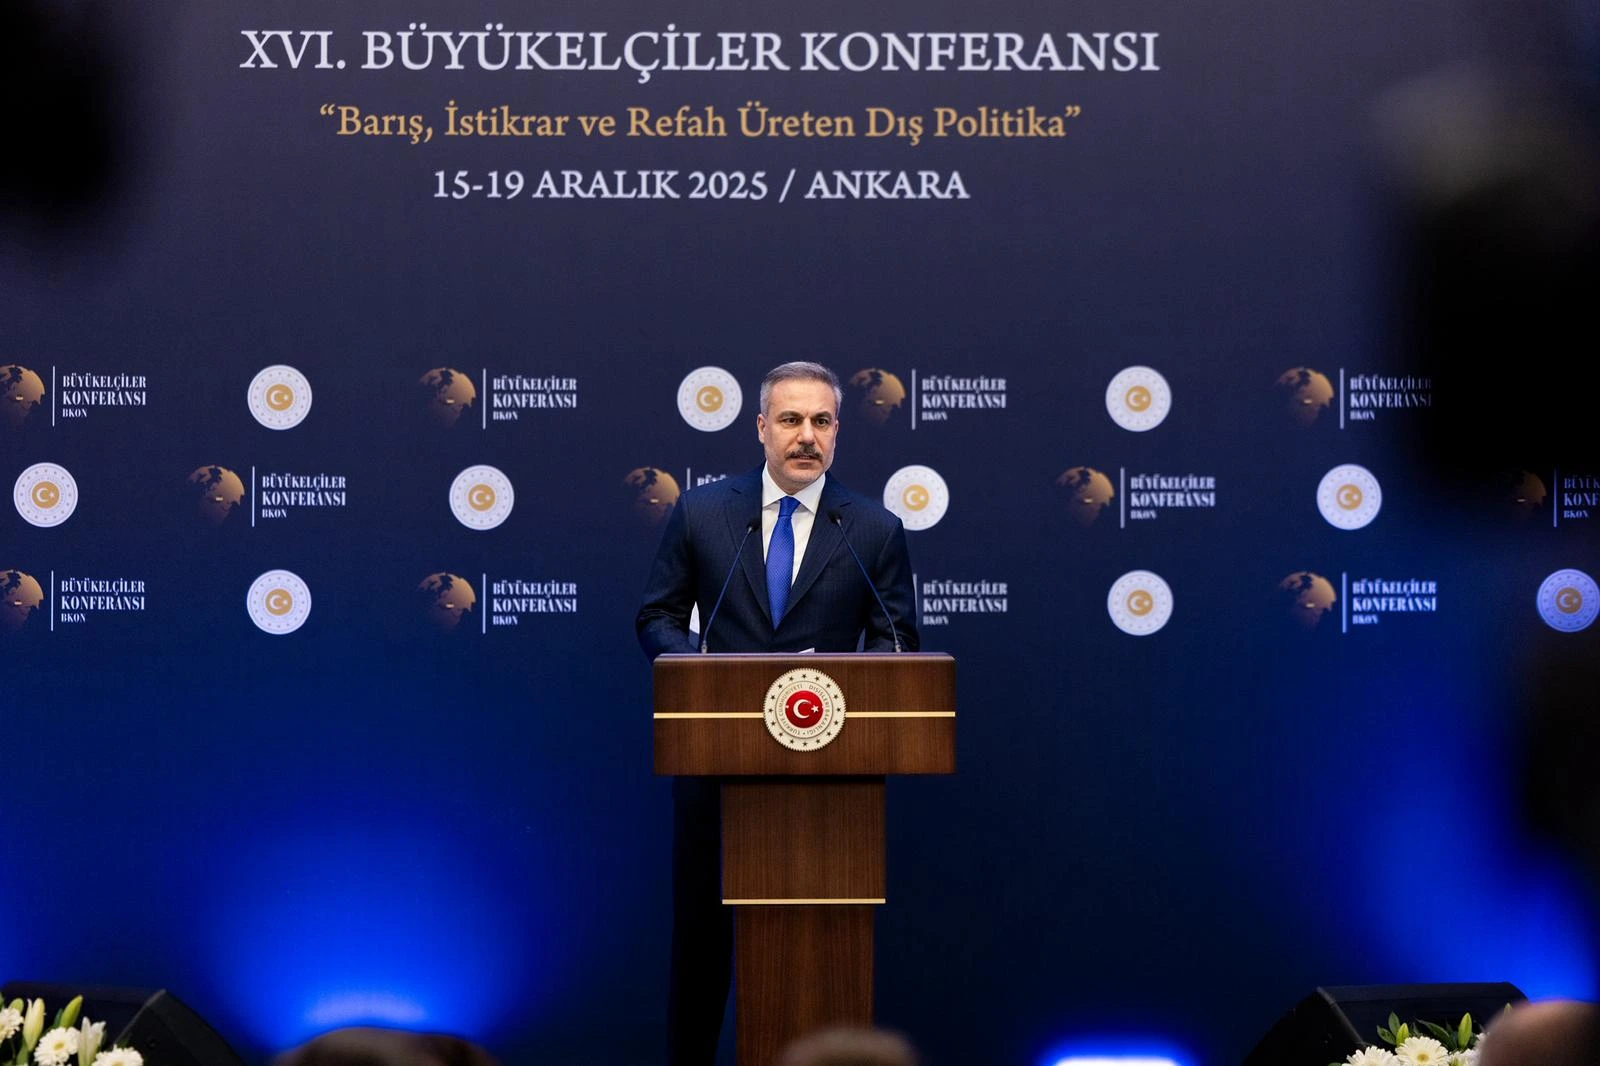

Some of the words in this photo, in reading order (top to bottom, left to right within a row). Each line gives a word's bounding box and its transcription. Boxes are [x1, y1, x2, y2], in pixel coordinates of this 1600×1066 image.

[239, 30, 347, 70] XVI.
[361, 22, 791, 84] BÜYÜKELÇİLER
[800, 32, 1160, 72] KONFERANSI
[320, 104, 433, 144] “Barış,
[444, 100, 569, 136] İstikrar
[577, 115, 616, 137] ve
[627, 105, 728, 136] Refah
[737, 101, 856, 137] Üreten
[865, 106, 923, 146] Dış
[934, 104, 1081, 137] Politika”
[434, 170, 524, 199] 15-19
[532, 170, 681, 199] ARALIK
[688, 170, 768, 200] 2025
[779, 168, 796, 203] /
[804, 170, 971, 199] ANKARA
[62, 373, 147, 391] BÜYÜKELÇİLER
[492, 375, 577, 393] BÜYÜKELÇİLER
[921, 376, 1007, 394] BÜYÜKELÇİLER
[62, 391, 147, 405] KONFERANSI
[492, 393, 577, 407] KONFERANSI
[921, 394, 1007, 408] KONFERANSI
[62, 408, 87, 418] BKON
[261, 473, 346, 491] BÜYÜKELÇİLER
[1130, 474, 1216, 492] BÜYÜKELÇİLER
[261, 491, 346, 505] KONFERANSI
[1130, 492, 1216, 506] KONFERANSI
[261, 508, 286, 518] BKON
[61, 577, 145, 595] BÜYÜKELÇİLER
[492, 580, 577, 598] BÜYÜKELÇİLER
[922, 580, 1008, 598] BÜYÜKELÇİLER
[1352, 579, 1437, 597] BÜYÜKELÇİLER
[61, 595, 145, 609] KONFERANSI
[492, 598, 577, 612] KONFERANSI
[922, 598, 1008, 612] KONFERANSI
[1352, 597, 1437, 611] KONFERANSI
[61, 612, 86, 622] BKON
